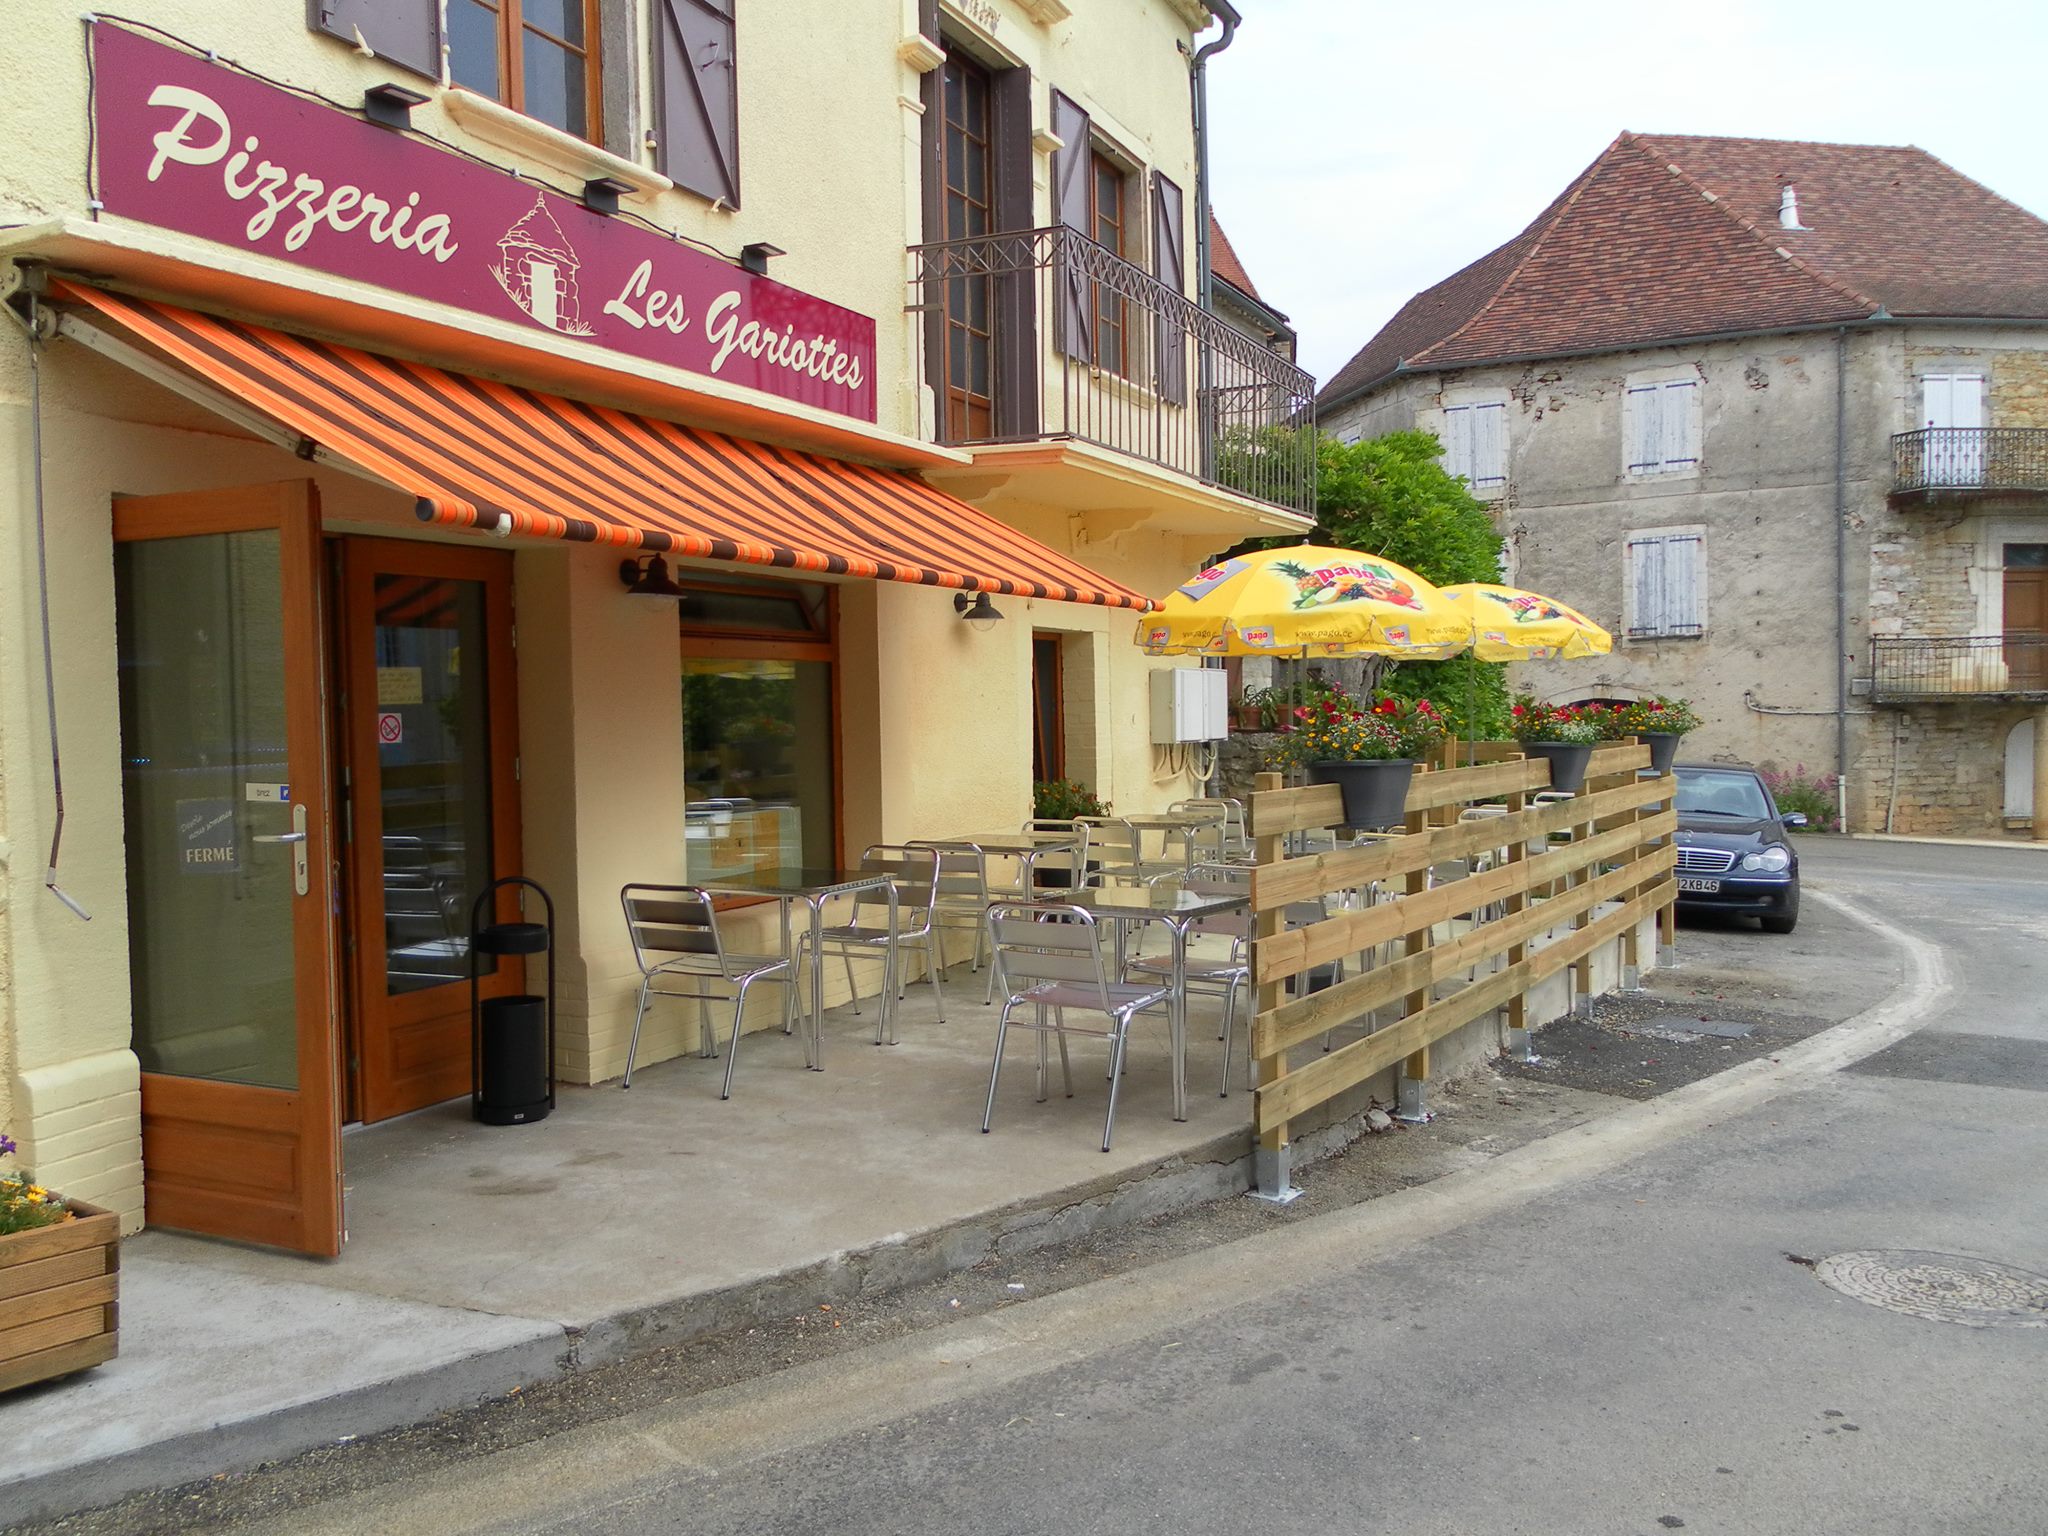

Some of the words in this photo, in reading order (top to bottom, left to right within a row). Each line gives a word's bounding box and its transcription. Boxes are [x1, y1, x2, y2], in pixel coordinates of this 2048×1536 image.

[147, 84, 459, 263] Pizzeria
[603, 259, 690, 333] Les
[705, 290, 864, 390] Gariottes
[1314, 565, 1377, 586] pago
[1514, 595, 1541, 609] pa
[1247, 631, 1268, 641] pago
[186, 840, 234, 863] FERMÉ
